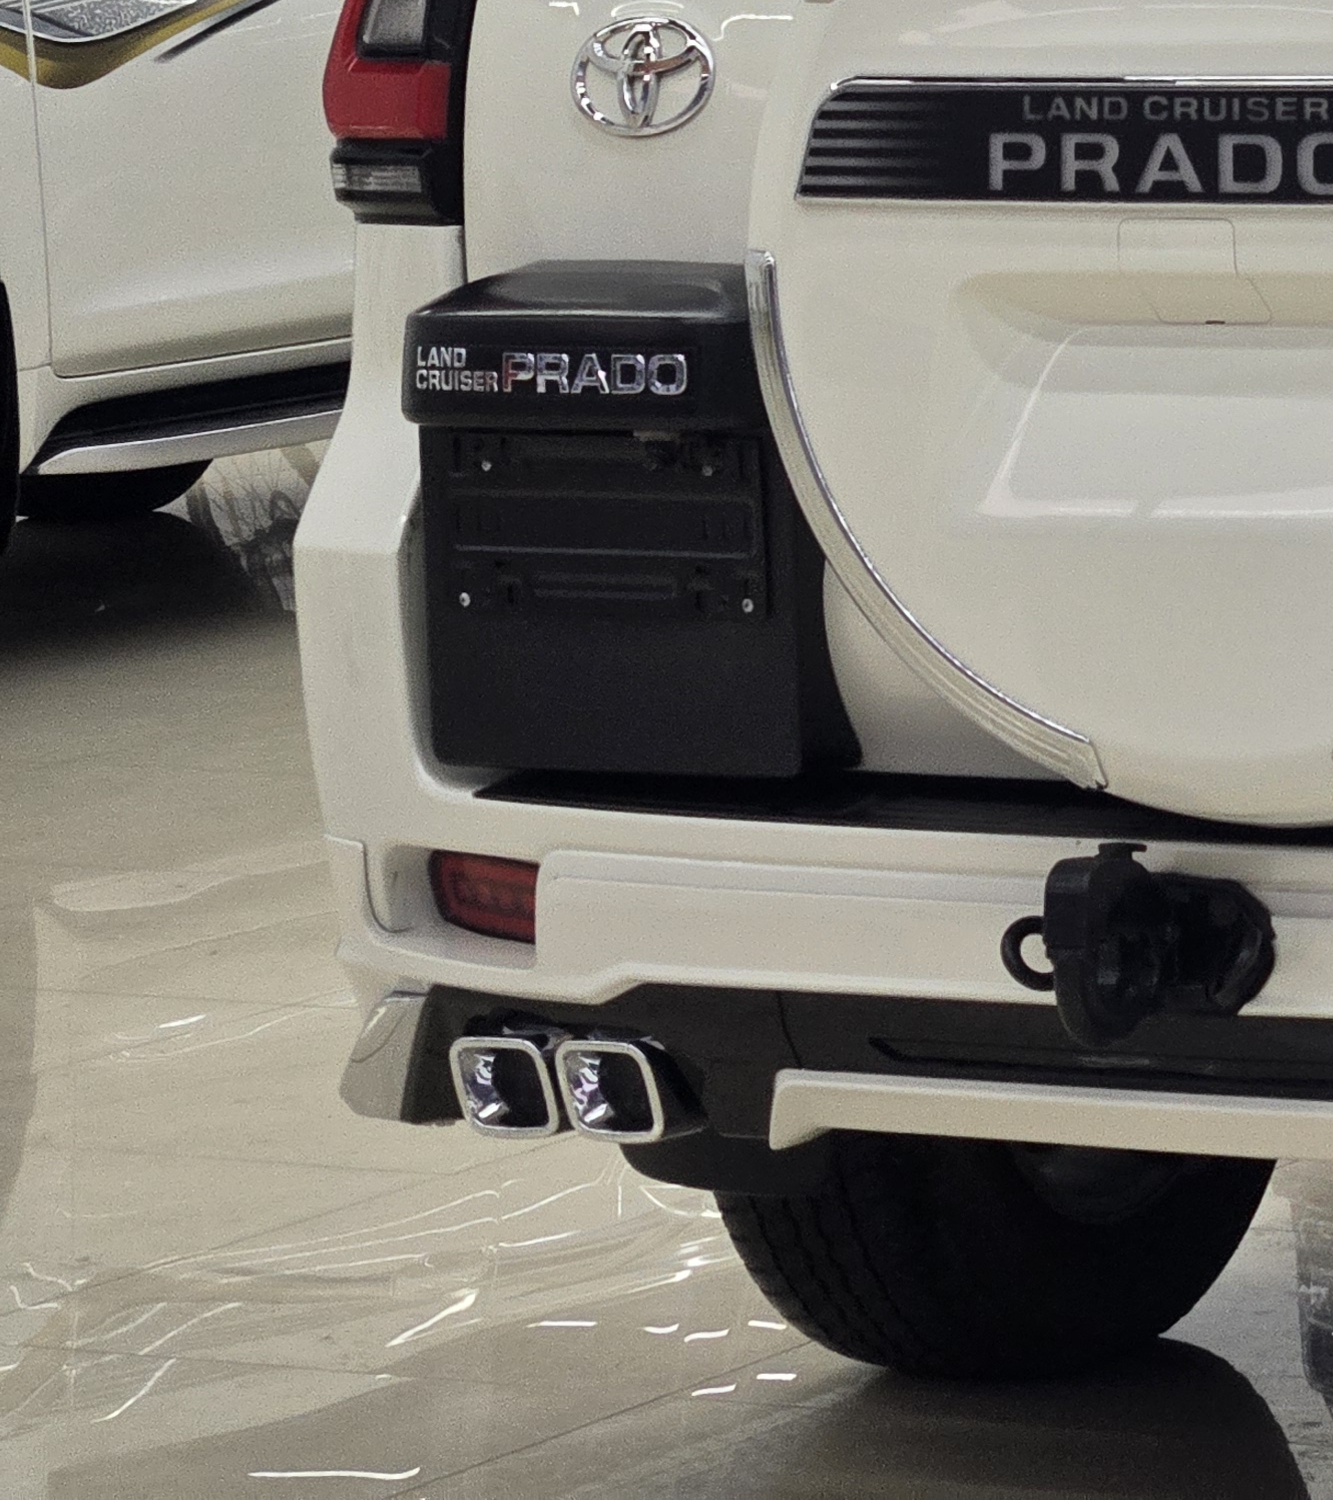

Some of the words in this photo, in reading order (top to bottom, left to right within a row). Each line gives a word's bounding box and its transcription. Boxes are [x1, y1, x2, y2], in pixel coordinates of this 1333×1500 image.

[1022, 95, 1129, 121] LAND
[1142, 96, 1330, 122] CRUISER
[416, 346, 466, 368] LAND
[416, 370, 498, 392] CRUISER
[502, 352, 688, 396] PRADO
